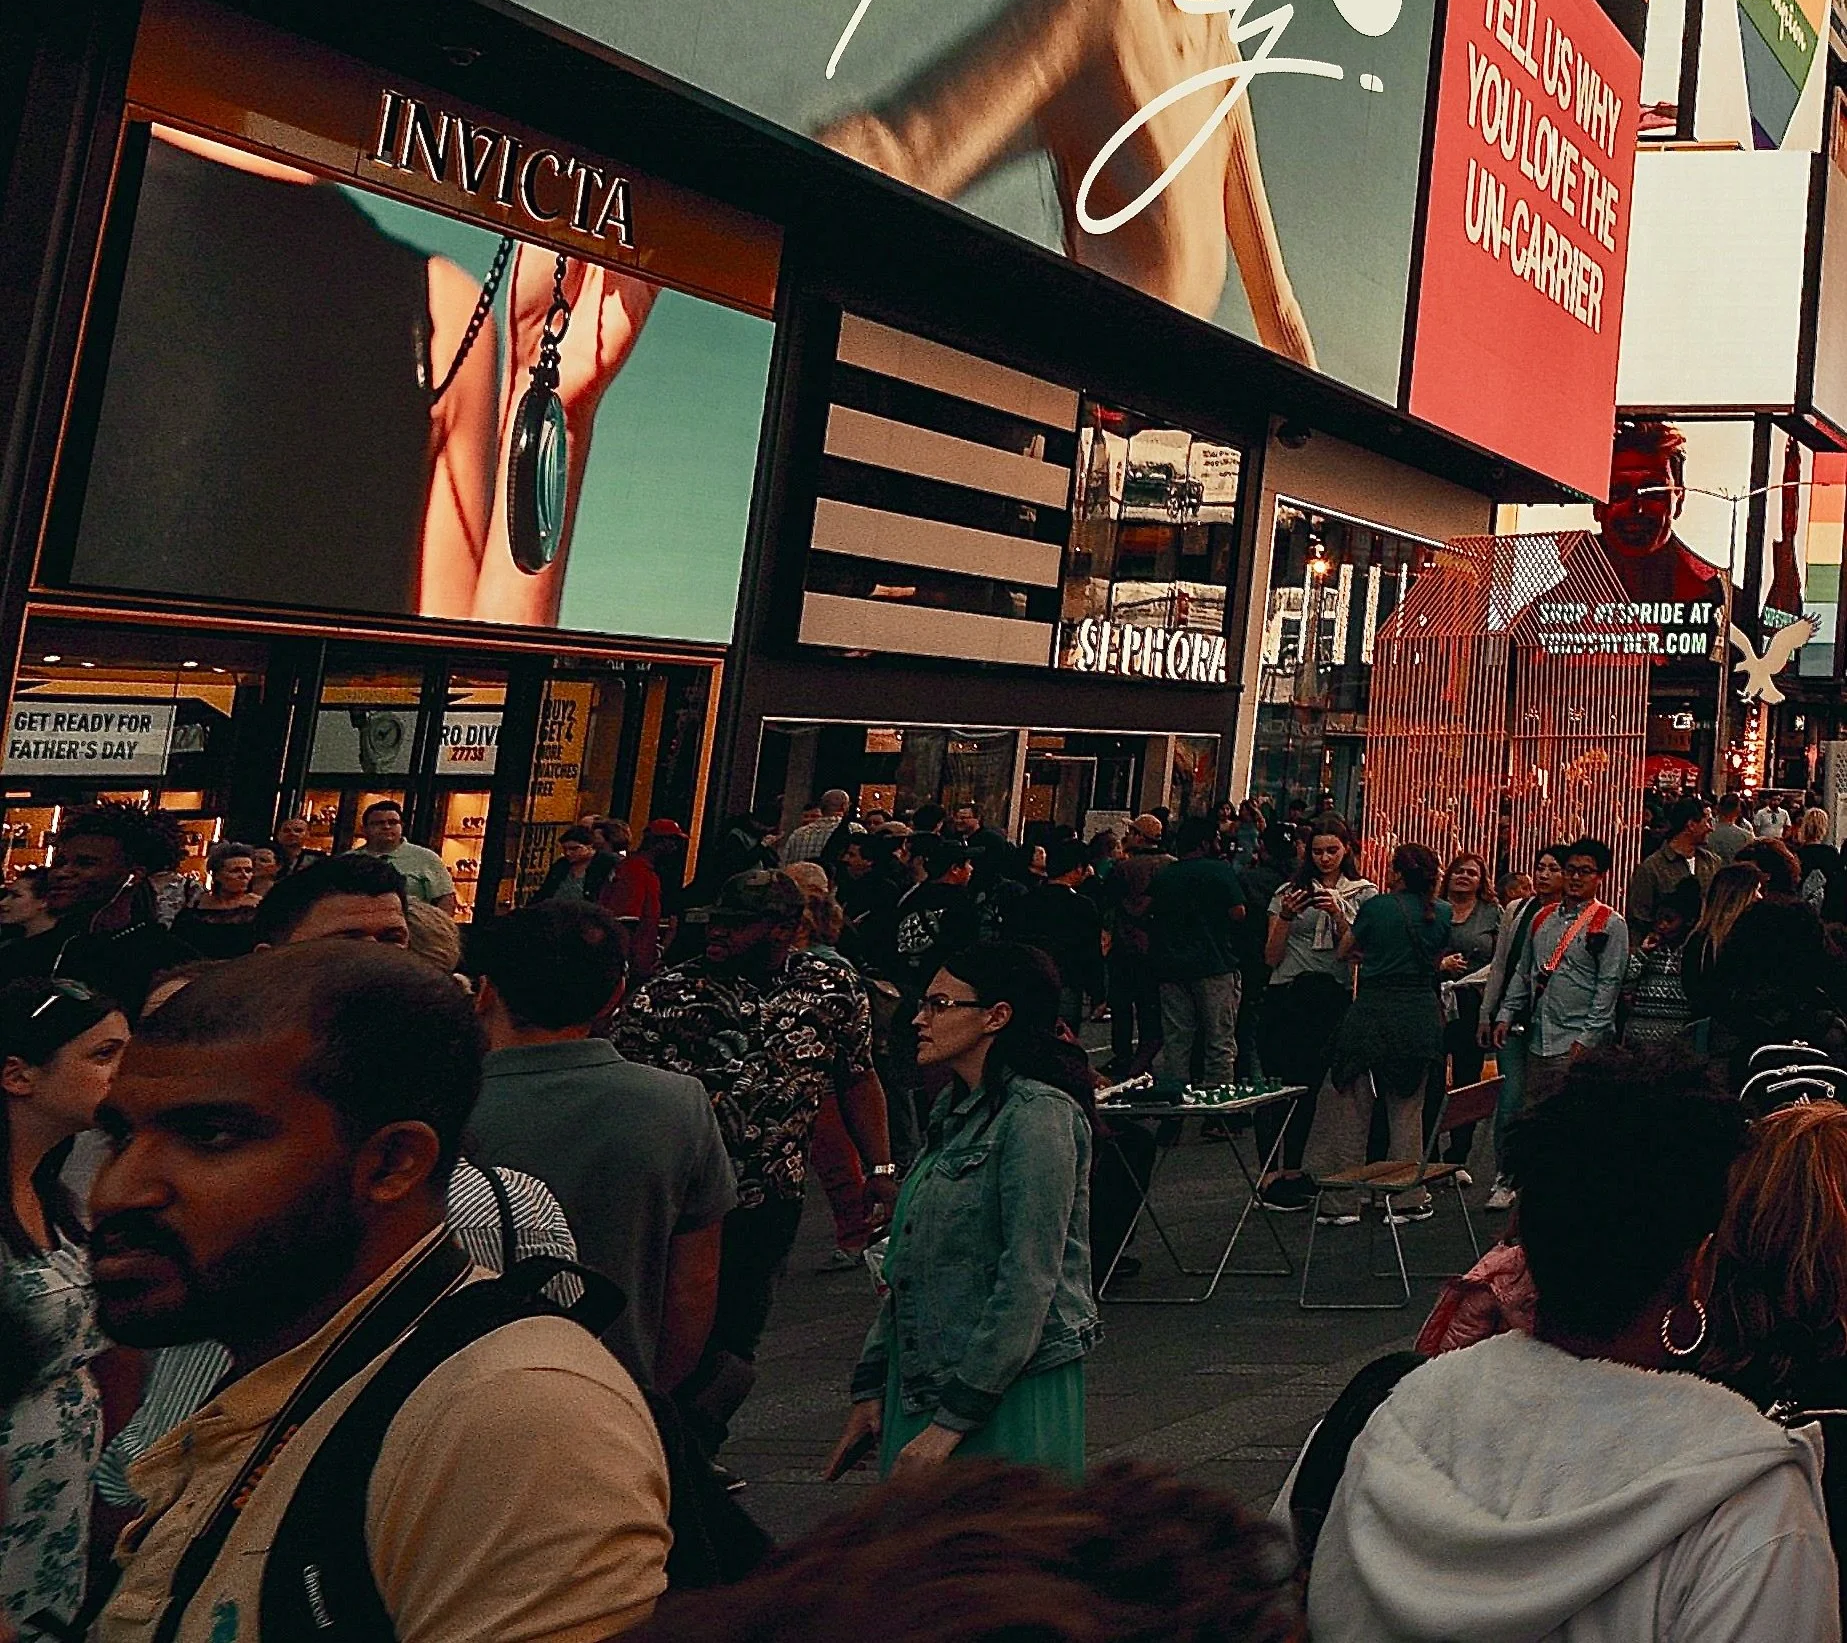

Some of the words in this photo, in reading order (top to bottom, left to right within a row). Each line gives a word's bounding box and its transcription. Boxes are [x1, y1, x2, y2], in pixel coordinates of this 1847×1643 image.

[1542, 16, 1575, 112] US
[1574, 52, 1623, 159] WHY
[373, 87, 636, 249] INVICTA
[1467, 40, 1522, 162] YOU
[1519, 99, 1579, 218] LOVE
[1578, 155, 1620, 253] THE
[1463, 157, 1605, 335] UN-CARRIER
[1075, 617, 1227, 684] SEPHORA
[1689, 602, 1713, 625] AT
[8, 739, 99, 760] FATHER'S
[101, 740, 139, 761] DAY
[13, 711, 52, 732] GET
[52, 712, 116, 733] READY
[116, 713, 152, 734] FOR
